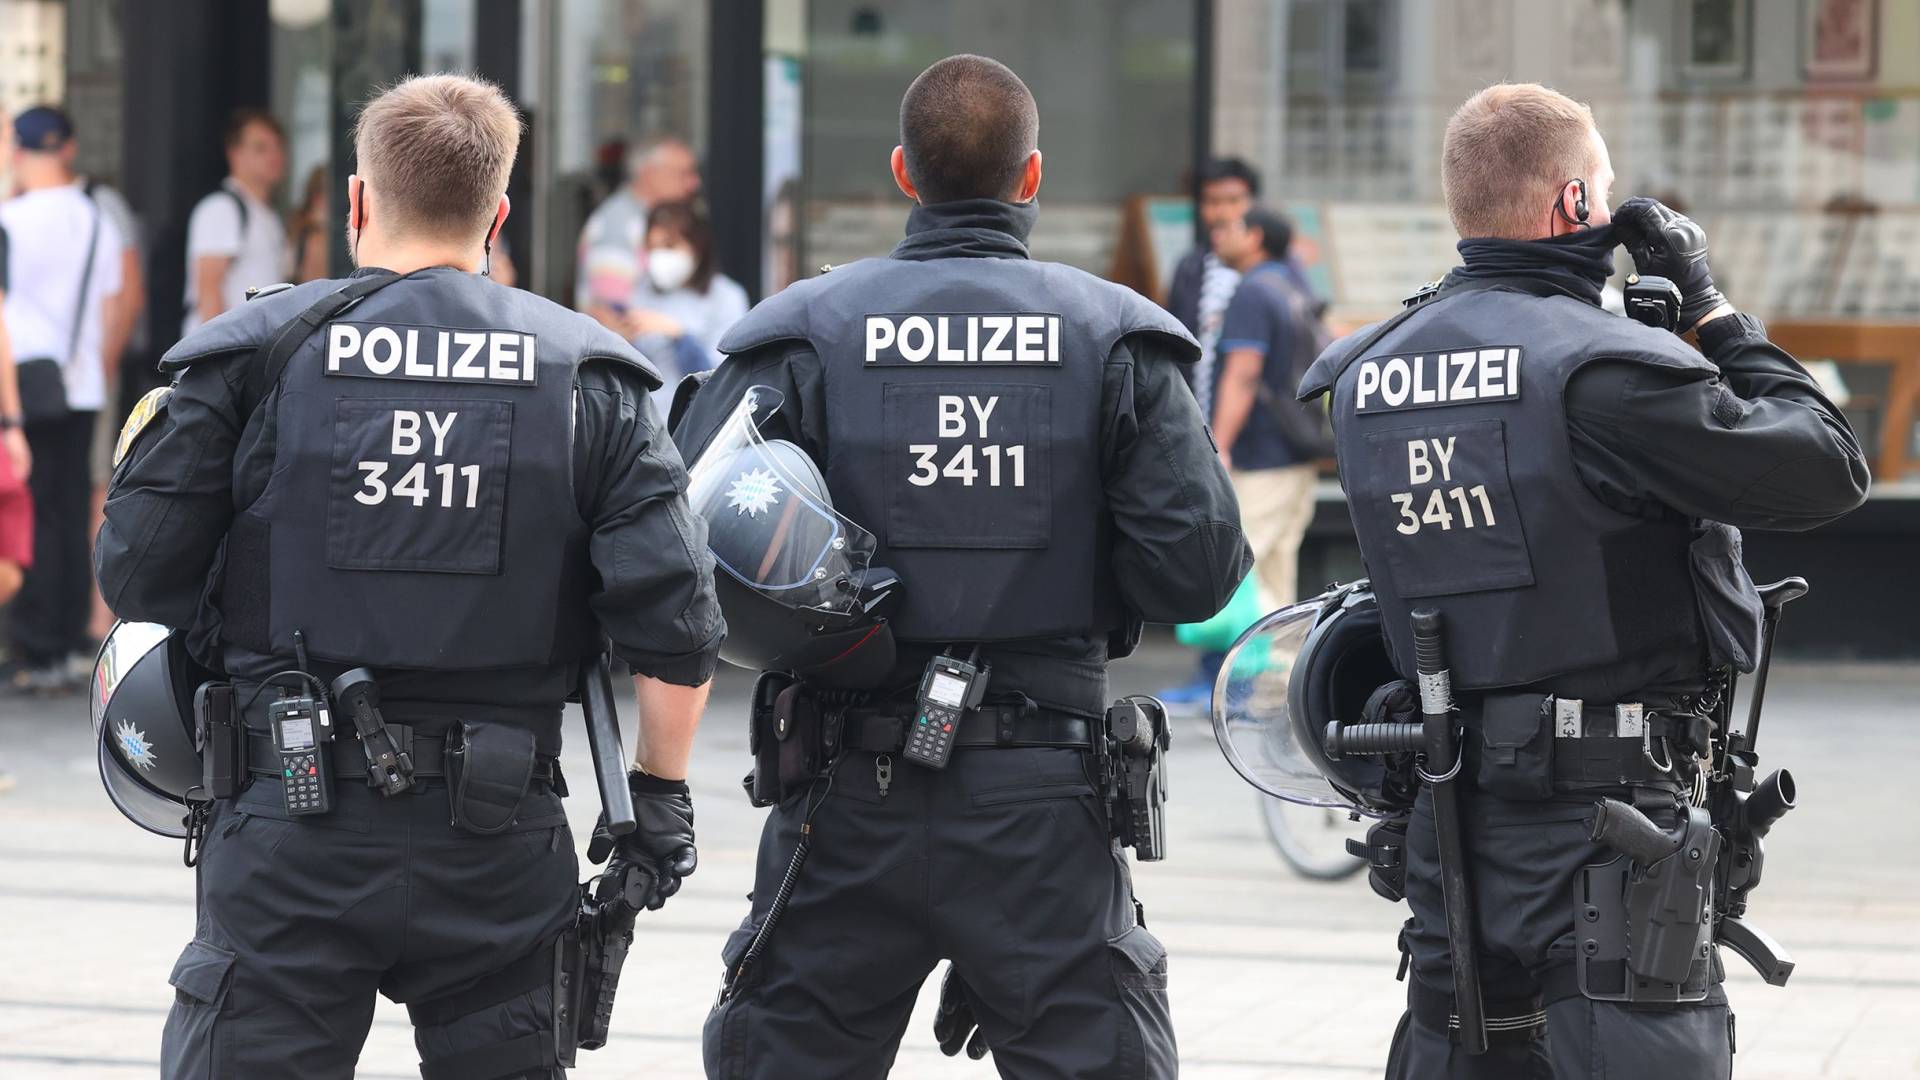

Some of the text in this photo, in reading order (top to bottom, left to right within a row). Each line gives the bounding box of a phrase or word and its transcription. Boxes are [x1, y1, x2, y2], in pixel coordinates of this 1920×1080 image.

[328, 324, 535, 381] POLIZEI
[866, 316, 1060, 362] POLIZEI
[1356, 348, 1520, 409] POLIZEI
[392, 410, 458, 456] BY
[939, 396, 999, 438] BY
[354, 461, 480, 508] 3411
[908, 445, 1025, 487] 3411
[1408, 437, 1457, 485] BY
[1391, 485, 1496, 535] 3411
